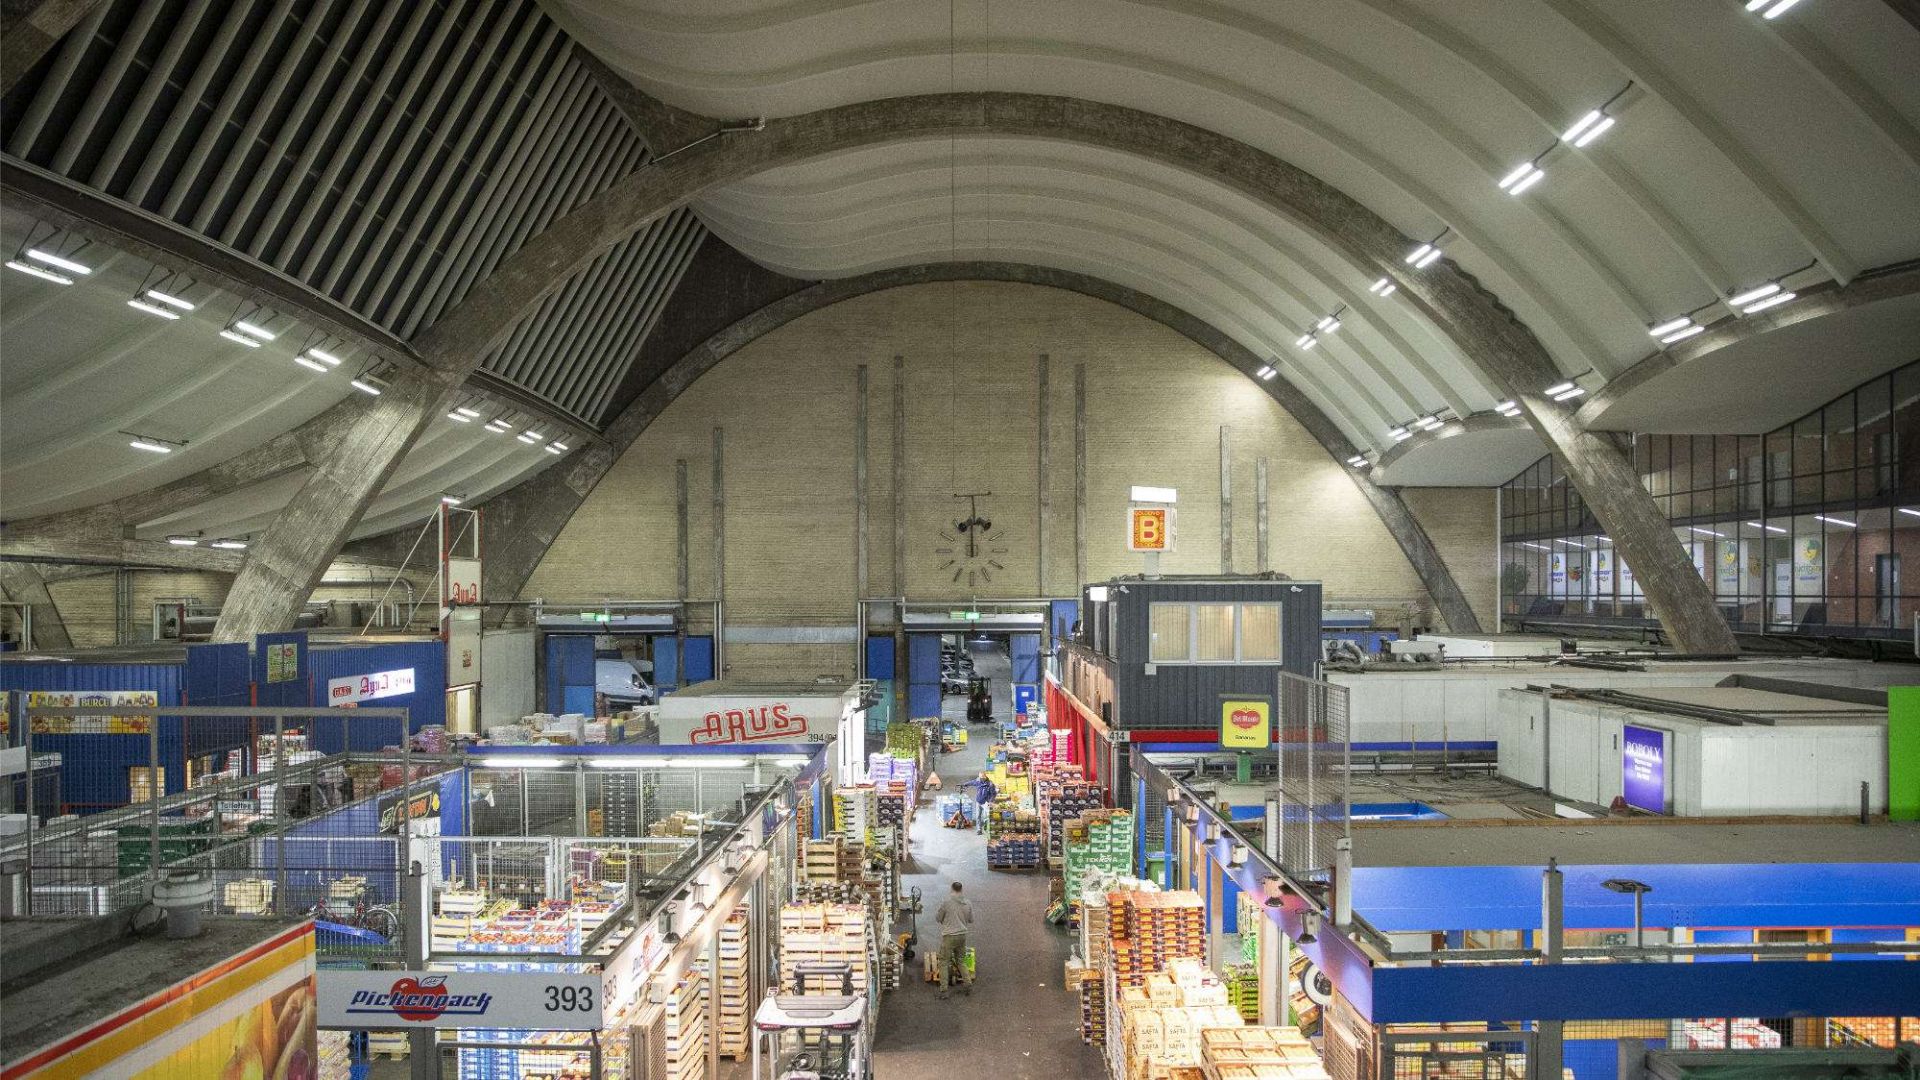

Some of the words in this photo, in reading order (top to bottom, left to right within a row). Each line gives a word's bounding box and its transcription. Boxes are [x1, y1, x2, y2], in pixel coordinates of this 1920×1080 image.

[1139, 516, 1159, 542] B
[703, 703, 791, 743] ARUS
[350, 990, 493, 1009] Pickenpack
[544, 985, 594, 1012] 393
